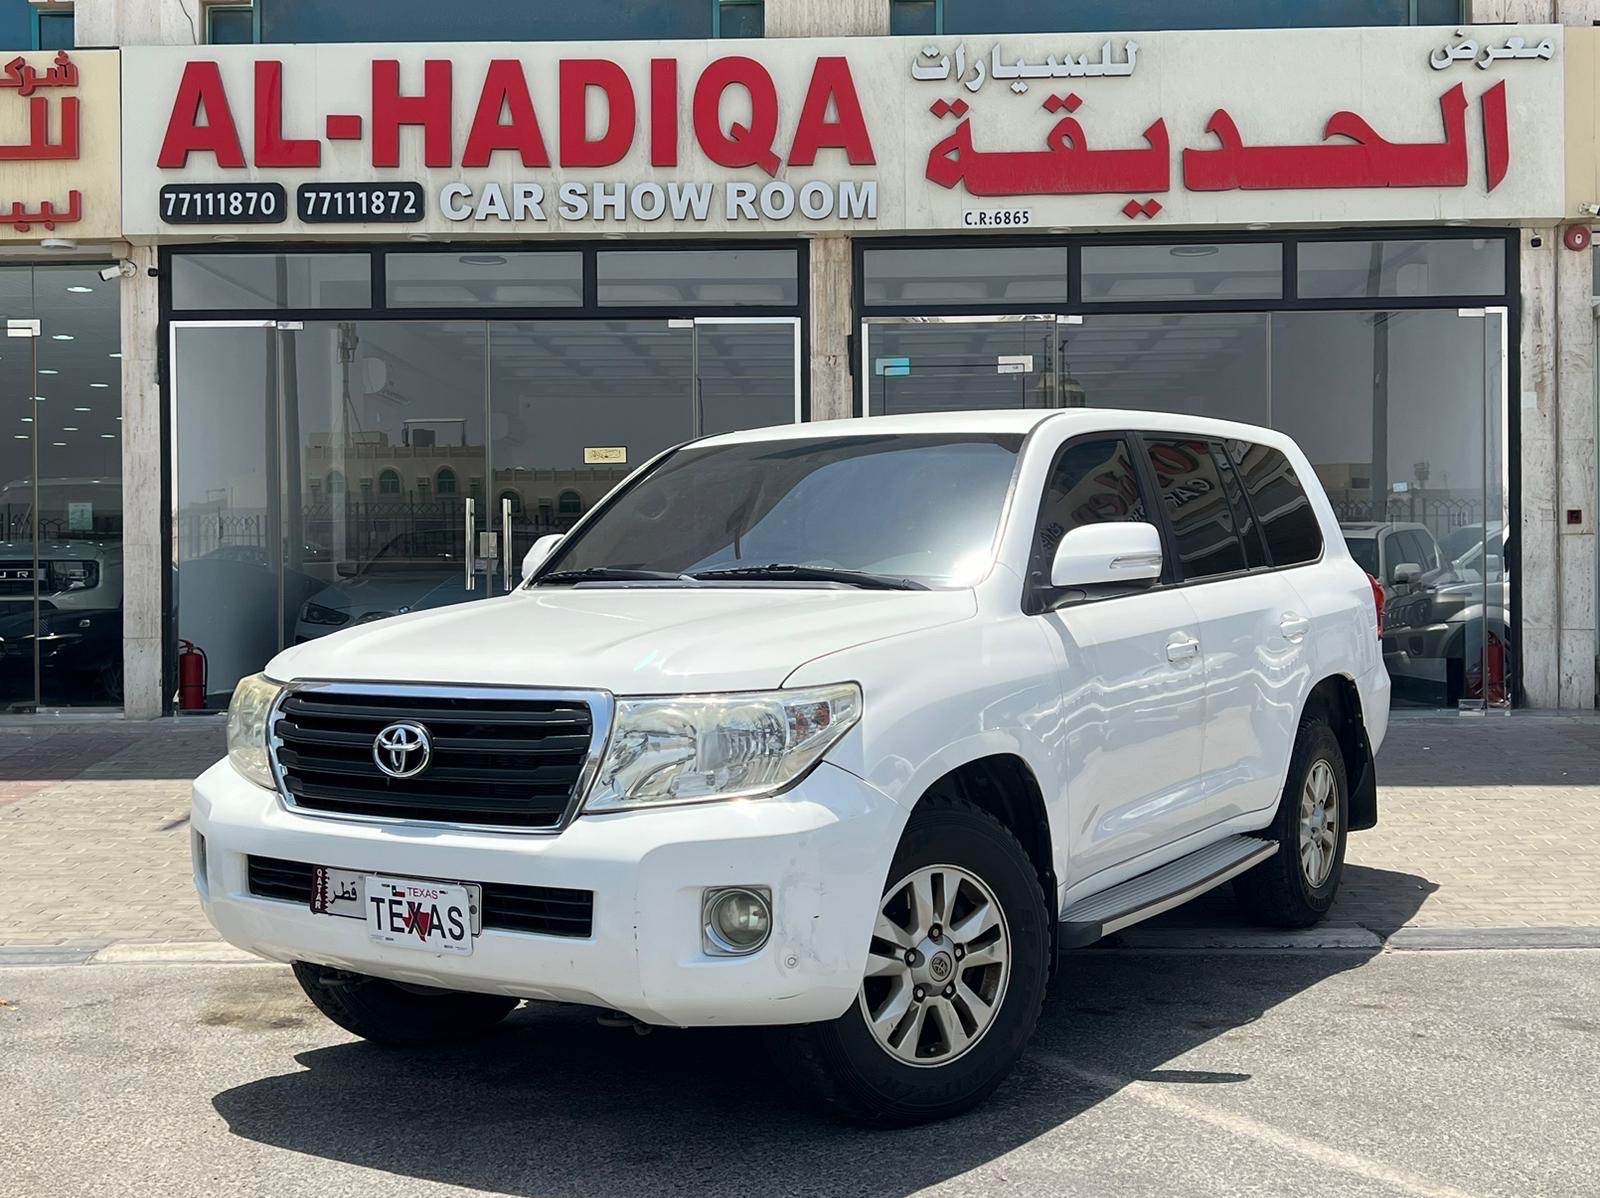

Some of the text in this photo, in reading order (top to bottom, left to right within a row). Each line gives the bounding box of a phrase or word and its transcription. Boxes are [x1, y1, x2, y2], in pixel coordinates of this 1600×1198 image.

[911, 39, 1140, 93] للسيارات
[1429, 29, 1555, 71] معرض
[156, 55, 877, 177] AL-HADIQA
[925, 78, 1510, 219] الحديقة
[164, 191, 276, 216] 77111870
[303, 190, 417, 215] 77111872
[439, 181, 879, 221] CAR SHOW ROOM
[964, 210, 1030, 226] C.R:6865
[314, 868, 323, 910] QATAR
[328, 880, 358, 904] قطر
[406, 886, 439, 900] TEXAS
[370, 896, 466, 942] TEXAS
